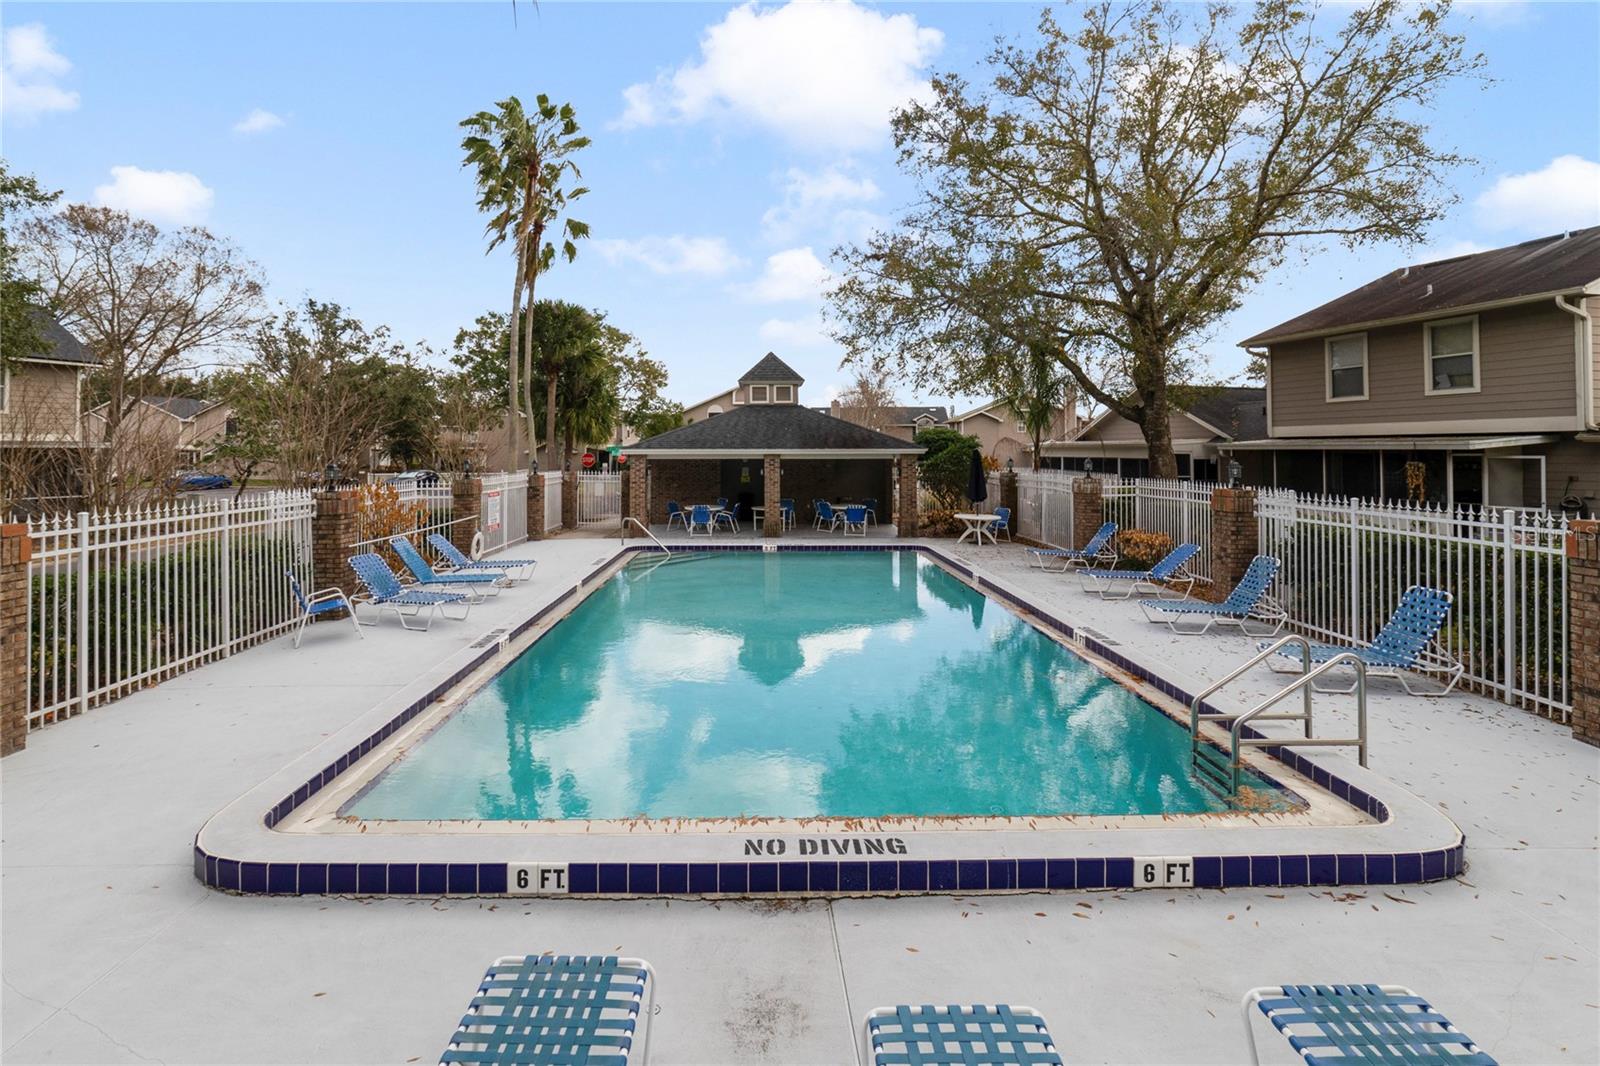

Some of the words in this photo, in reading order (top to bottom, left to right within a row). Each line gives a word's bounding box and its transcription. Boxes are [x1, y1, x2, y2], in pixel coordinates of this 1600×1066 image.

[744, 839, 786, 855] NO
[799, 838, 907, 855] DIVING
[517, 869, 528, 888] 6
[540, 869, 565, 888] FT.
[1143, 863, 1155, 883] 6
[1166, 863, 1190, 883] FT.
